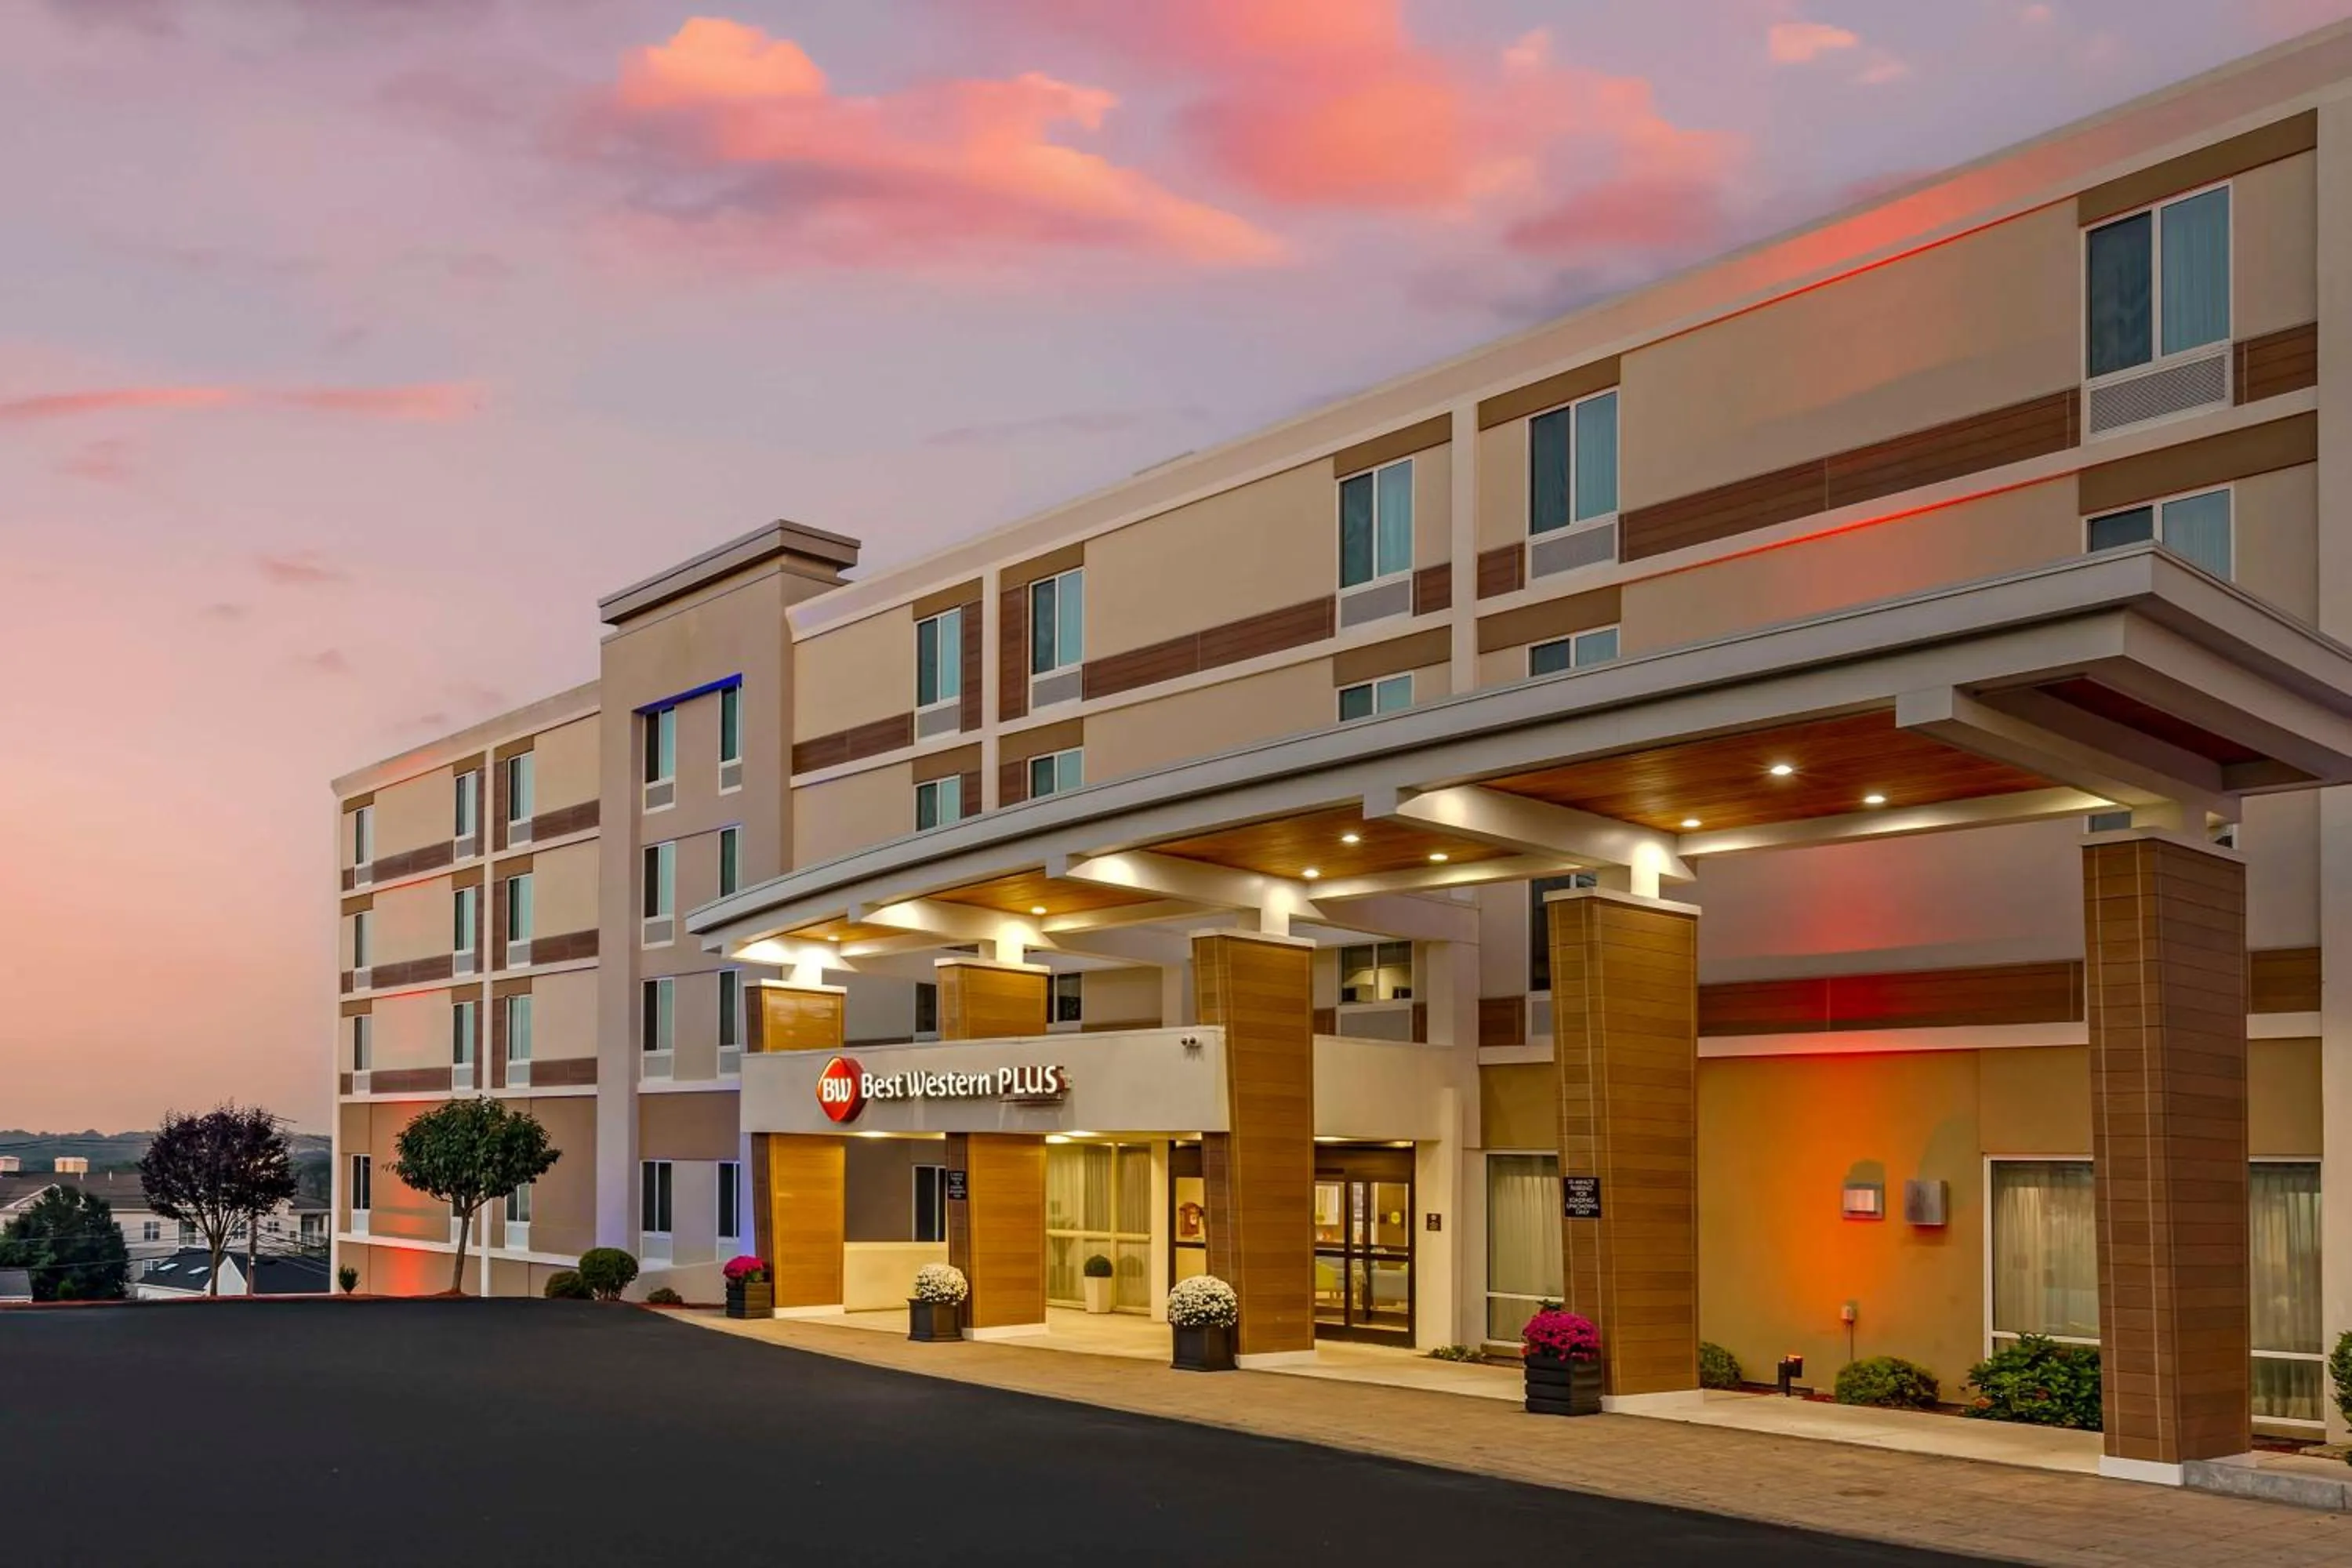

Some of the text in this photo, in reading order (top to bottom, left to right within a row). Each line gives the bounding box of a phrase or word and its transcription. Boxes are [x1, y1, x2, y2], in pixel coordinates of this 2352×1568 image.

[822, 1077, 852, 1103] BW
[861, 1065, 1058, 1099] Best Western PLUS
